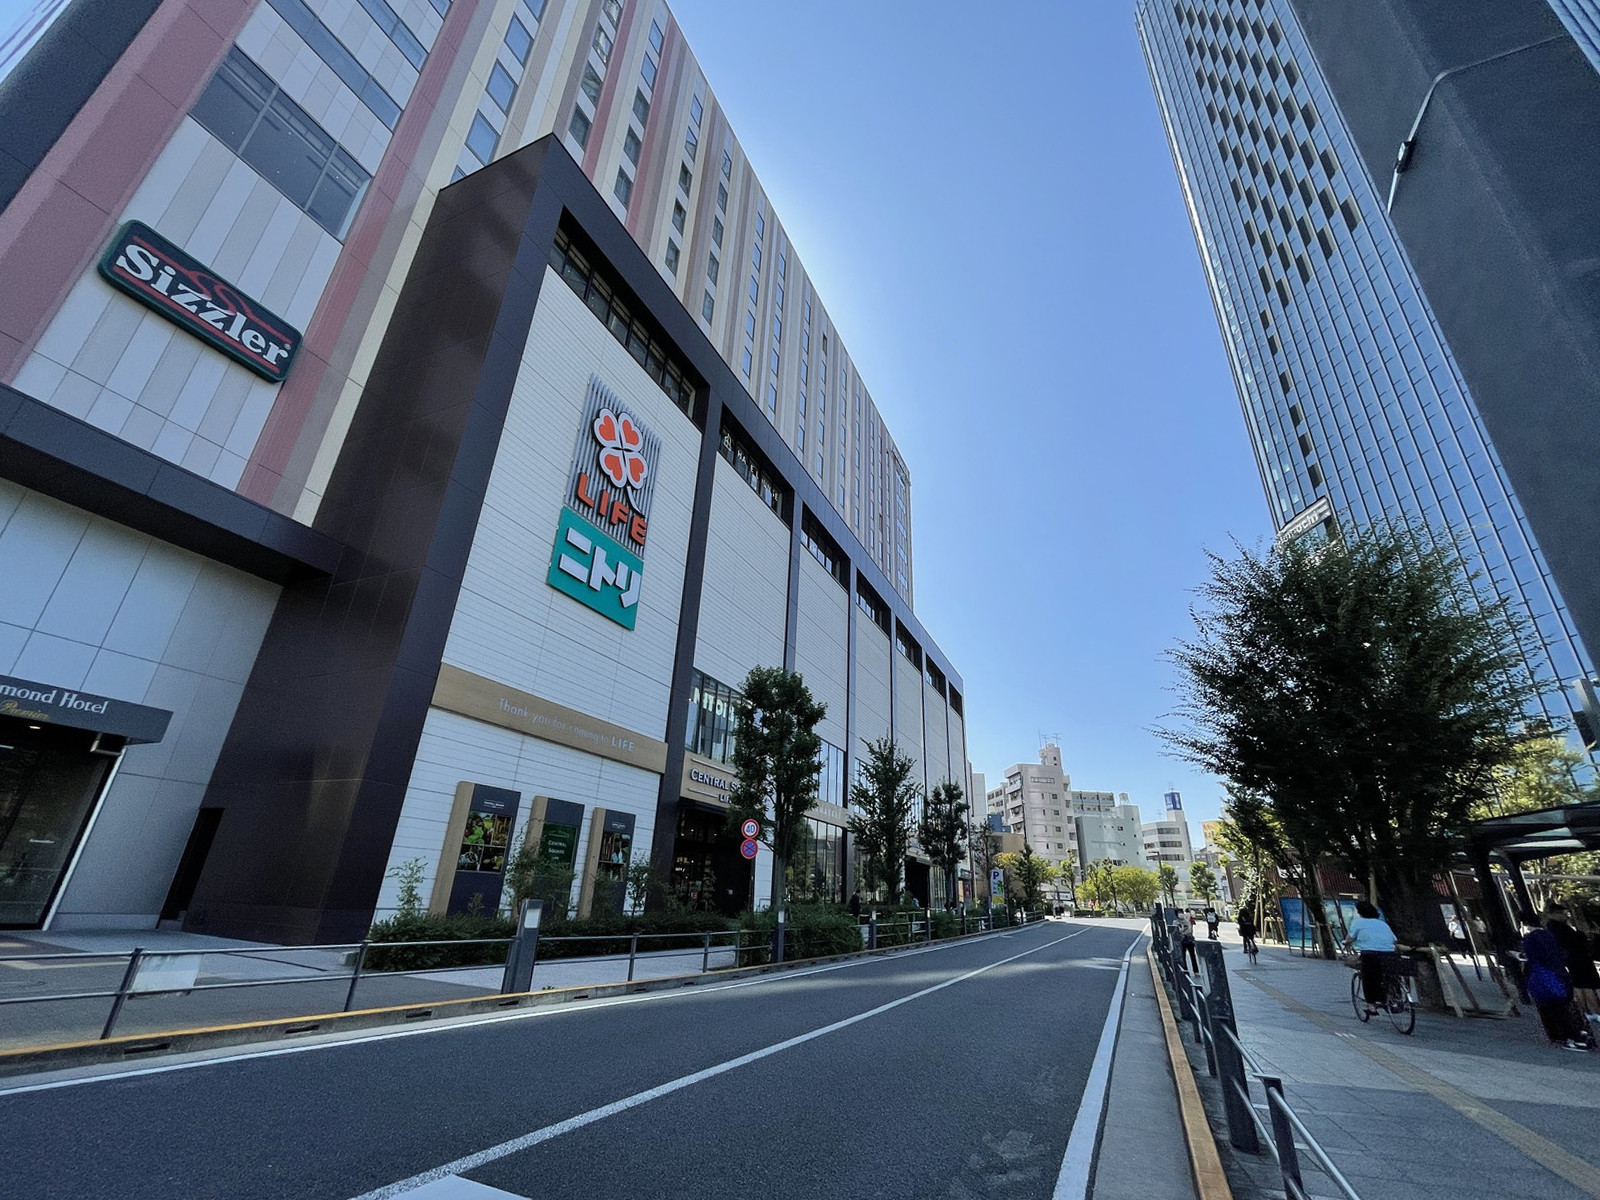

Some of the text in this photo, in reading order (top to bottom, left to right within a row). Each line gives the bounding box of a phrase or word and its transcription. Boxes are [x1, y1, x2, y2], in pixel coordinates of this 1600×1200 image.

[115, 243, 290, 366] Sizzler
[577, 471, 649, 547] LIFE
[558, 526, 642, 609] ニトリ
[59, 691, 109, 715] Hotel
[499, 697, 529, 718] Thank
[532, 713, 550, 724] you
[553, 715, 565, 730] for
[570, 725, 600, 744] coming
[611, 735, 636, 753] LIFE
[690, 768, 729, 791] CENTRAL
[745, 824, 756, 834] 40
[992, 871, 1000, 880] P
